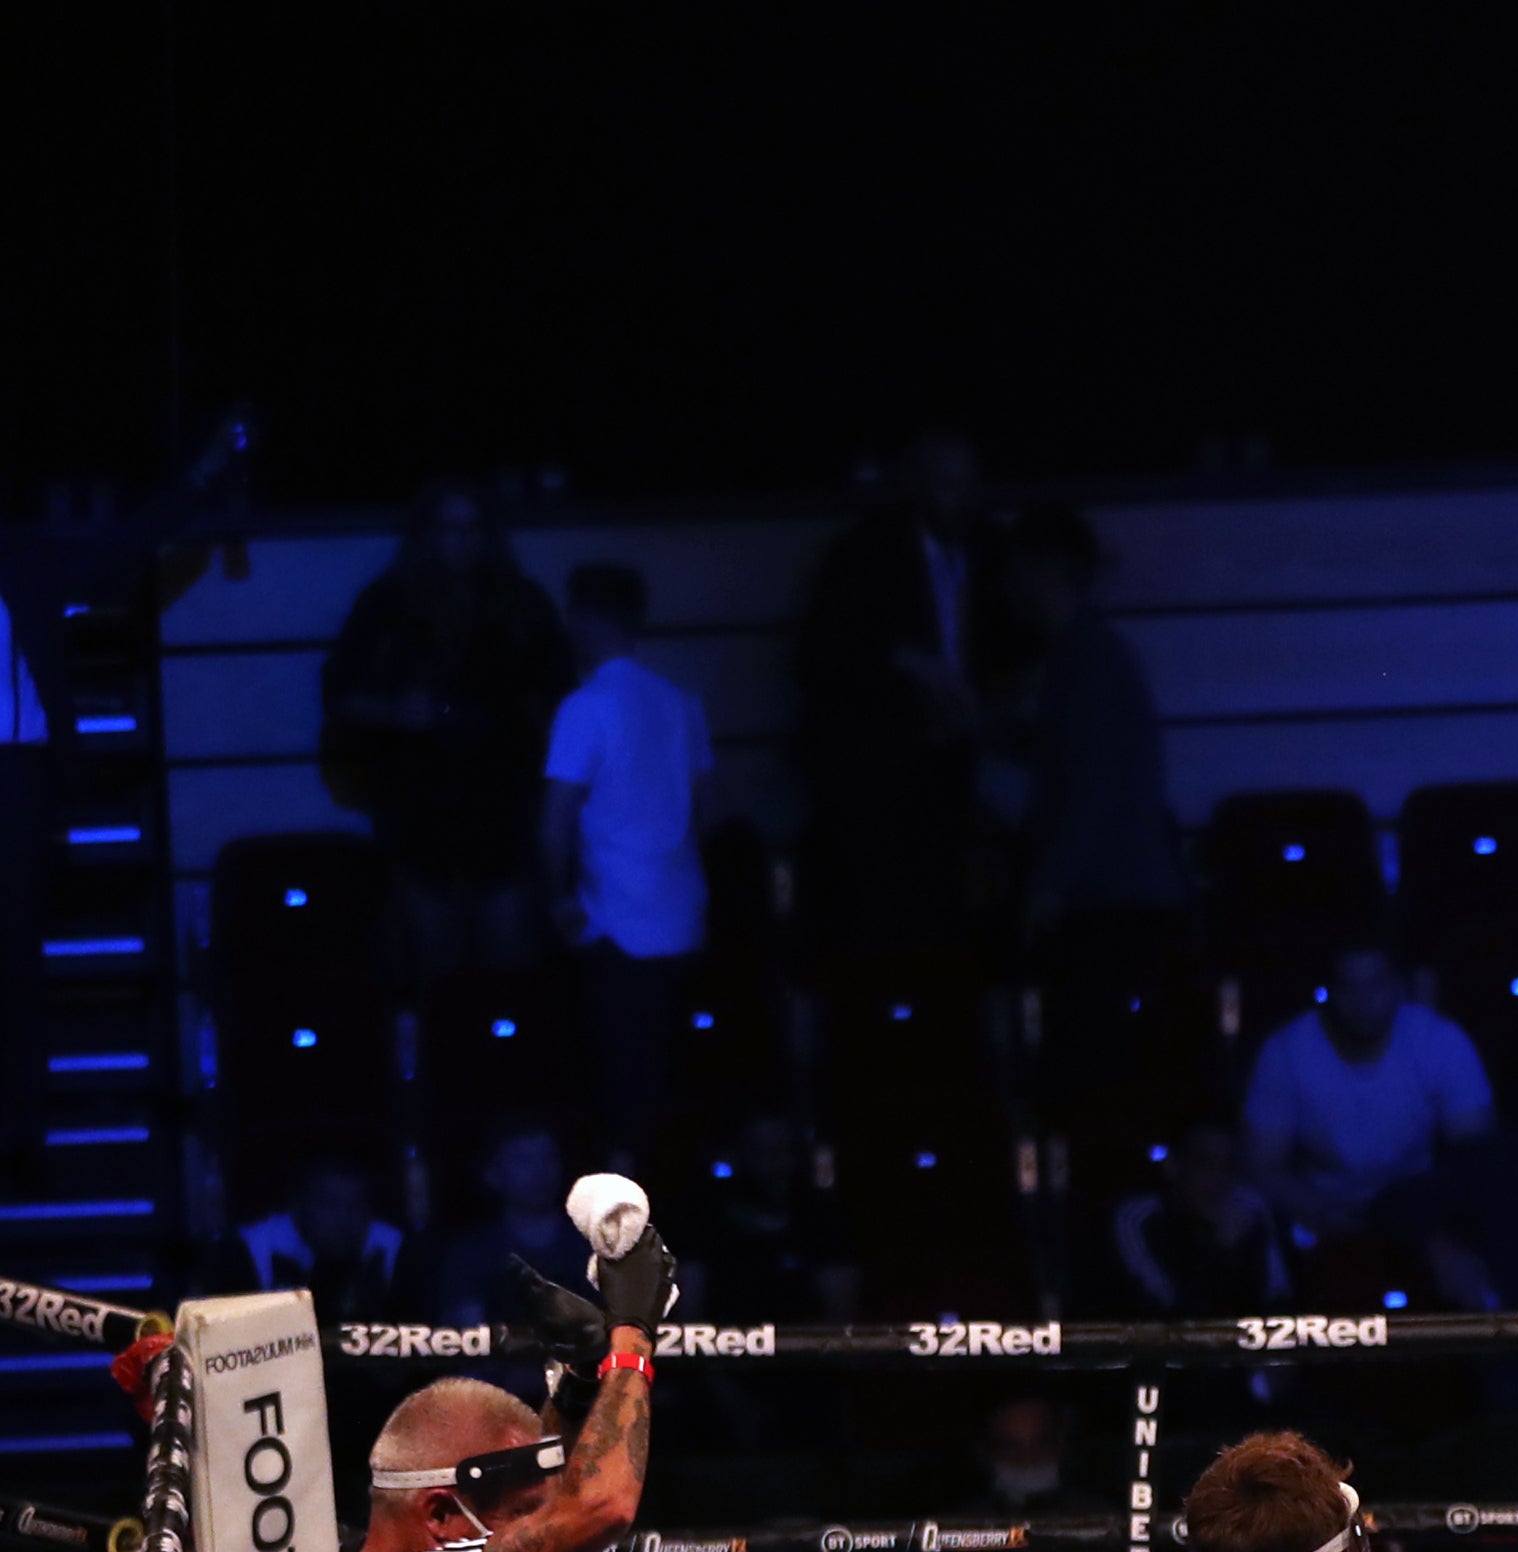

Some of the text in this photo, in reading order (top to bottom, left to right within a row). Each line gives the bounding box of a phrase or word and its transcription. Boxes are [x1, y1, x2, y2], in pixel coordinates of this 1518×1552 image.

[341, 1323, 491, 1357] 32Red
[652, 1323, 776, 1358] 2Red
[908, 1321, 1062, 1357] 32Red
[1236, 1314, 1388, 1350] 32Red
[854, 1533, 897, 1551] SPORT
